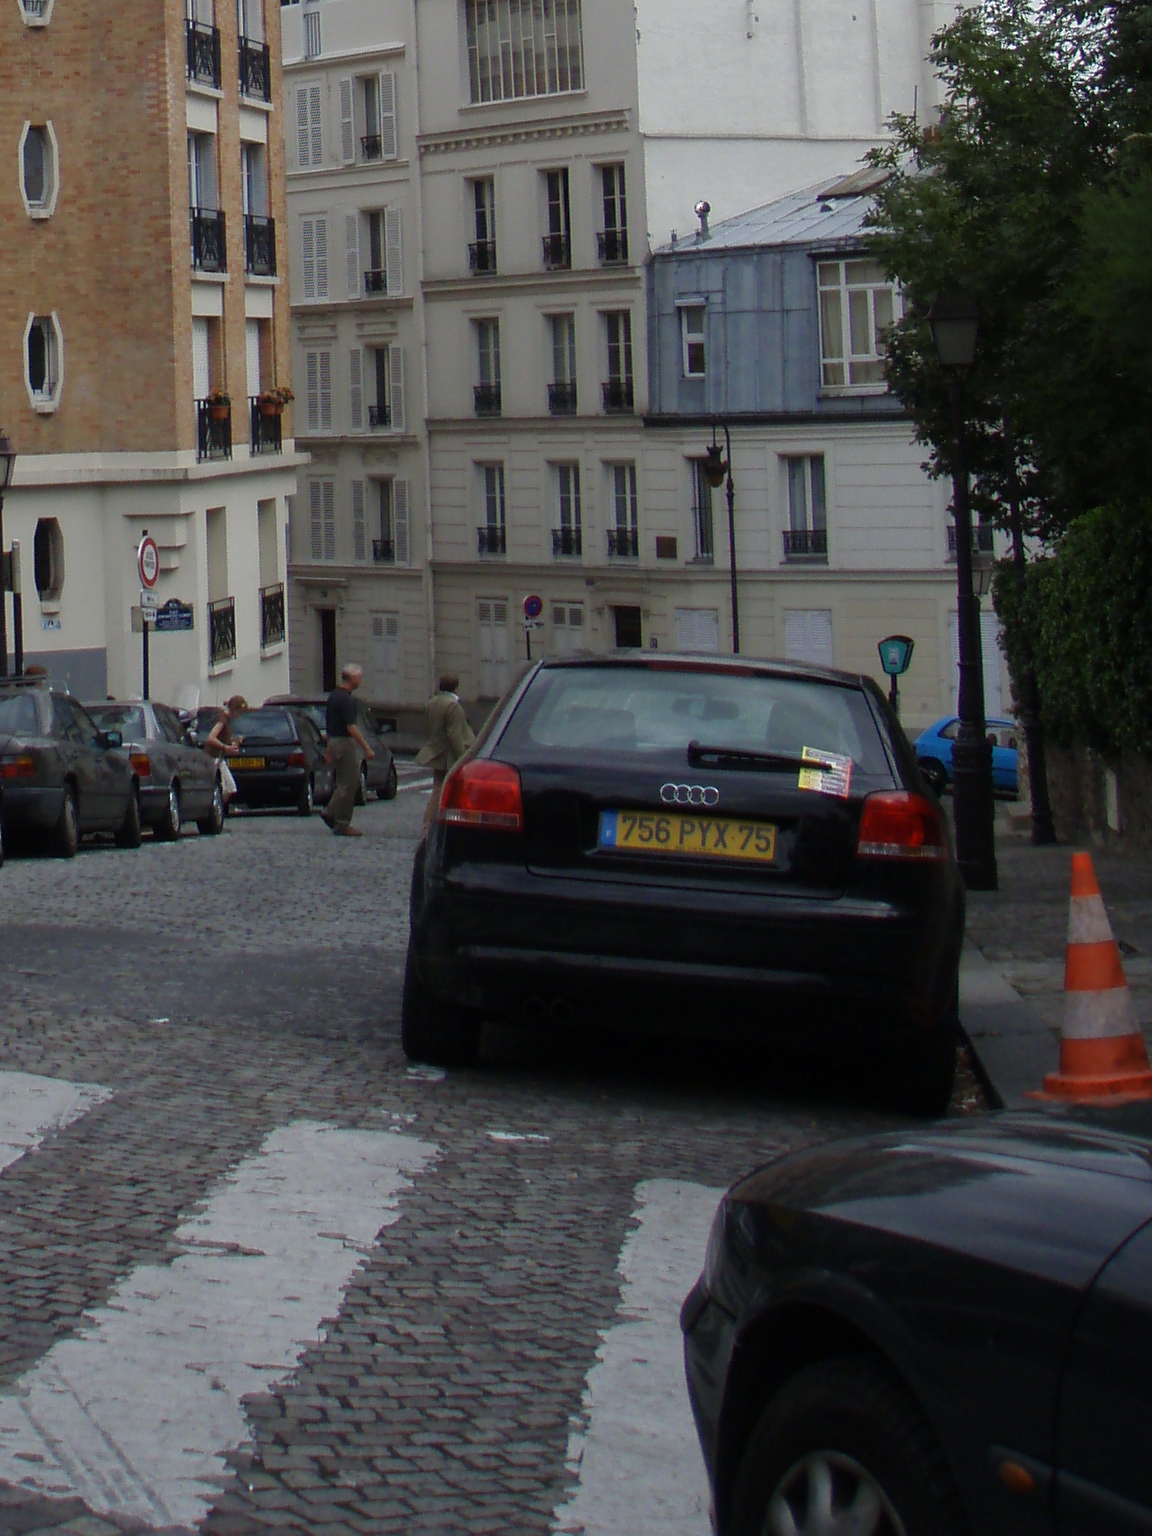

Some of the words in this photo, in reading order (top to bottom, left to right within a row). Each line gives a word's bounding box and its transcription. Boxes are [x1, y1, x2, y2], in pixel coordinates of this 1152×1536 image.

[621, 816, 671, 845] 756
[679, 819, 730, 850] PYX
[738, 824, 772, 854] 75
